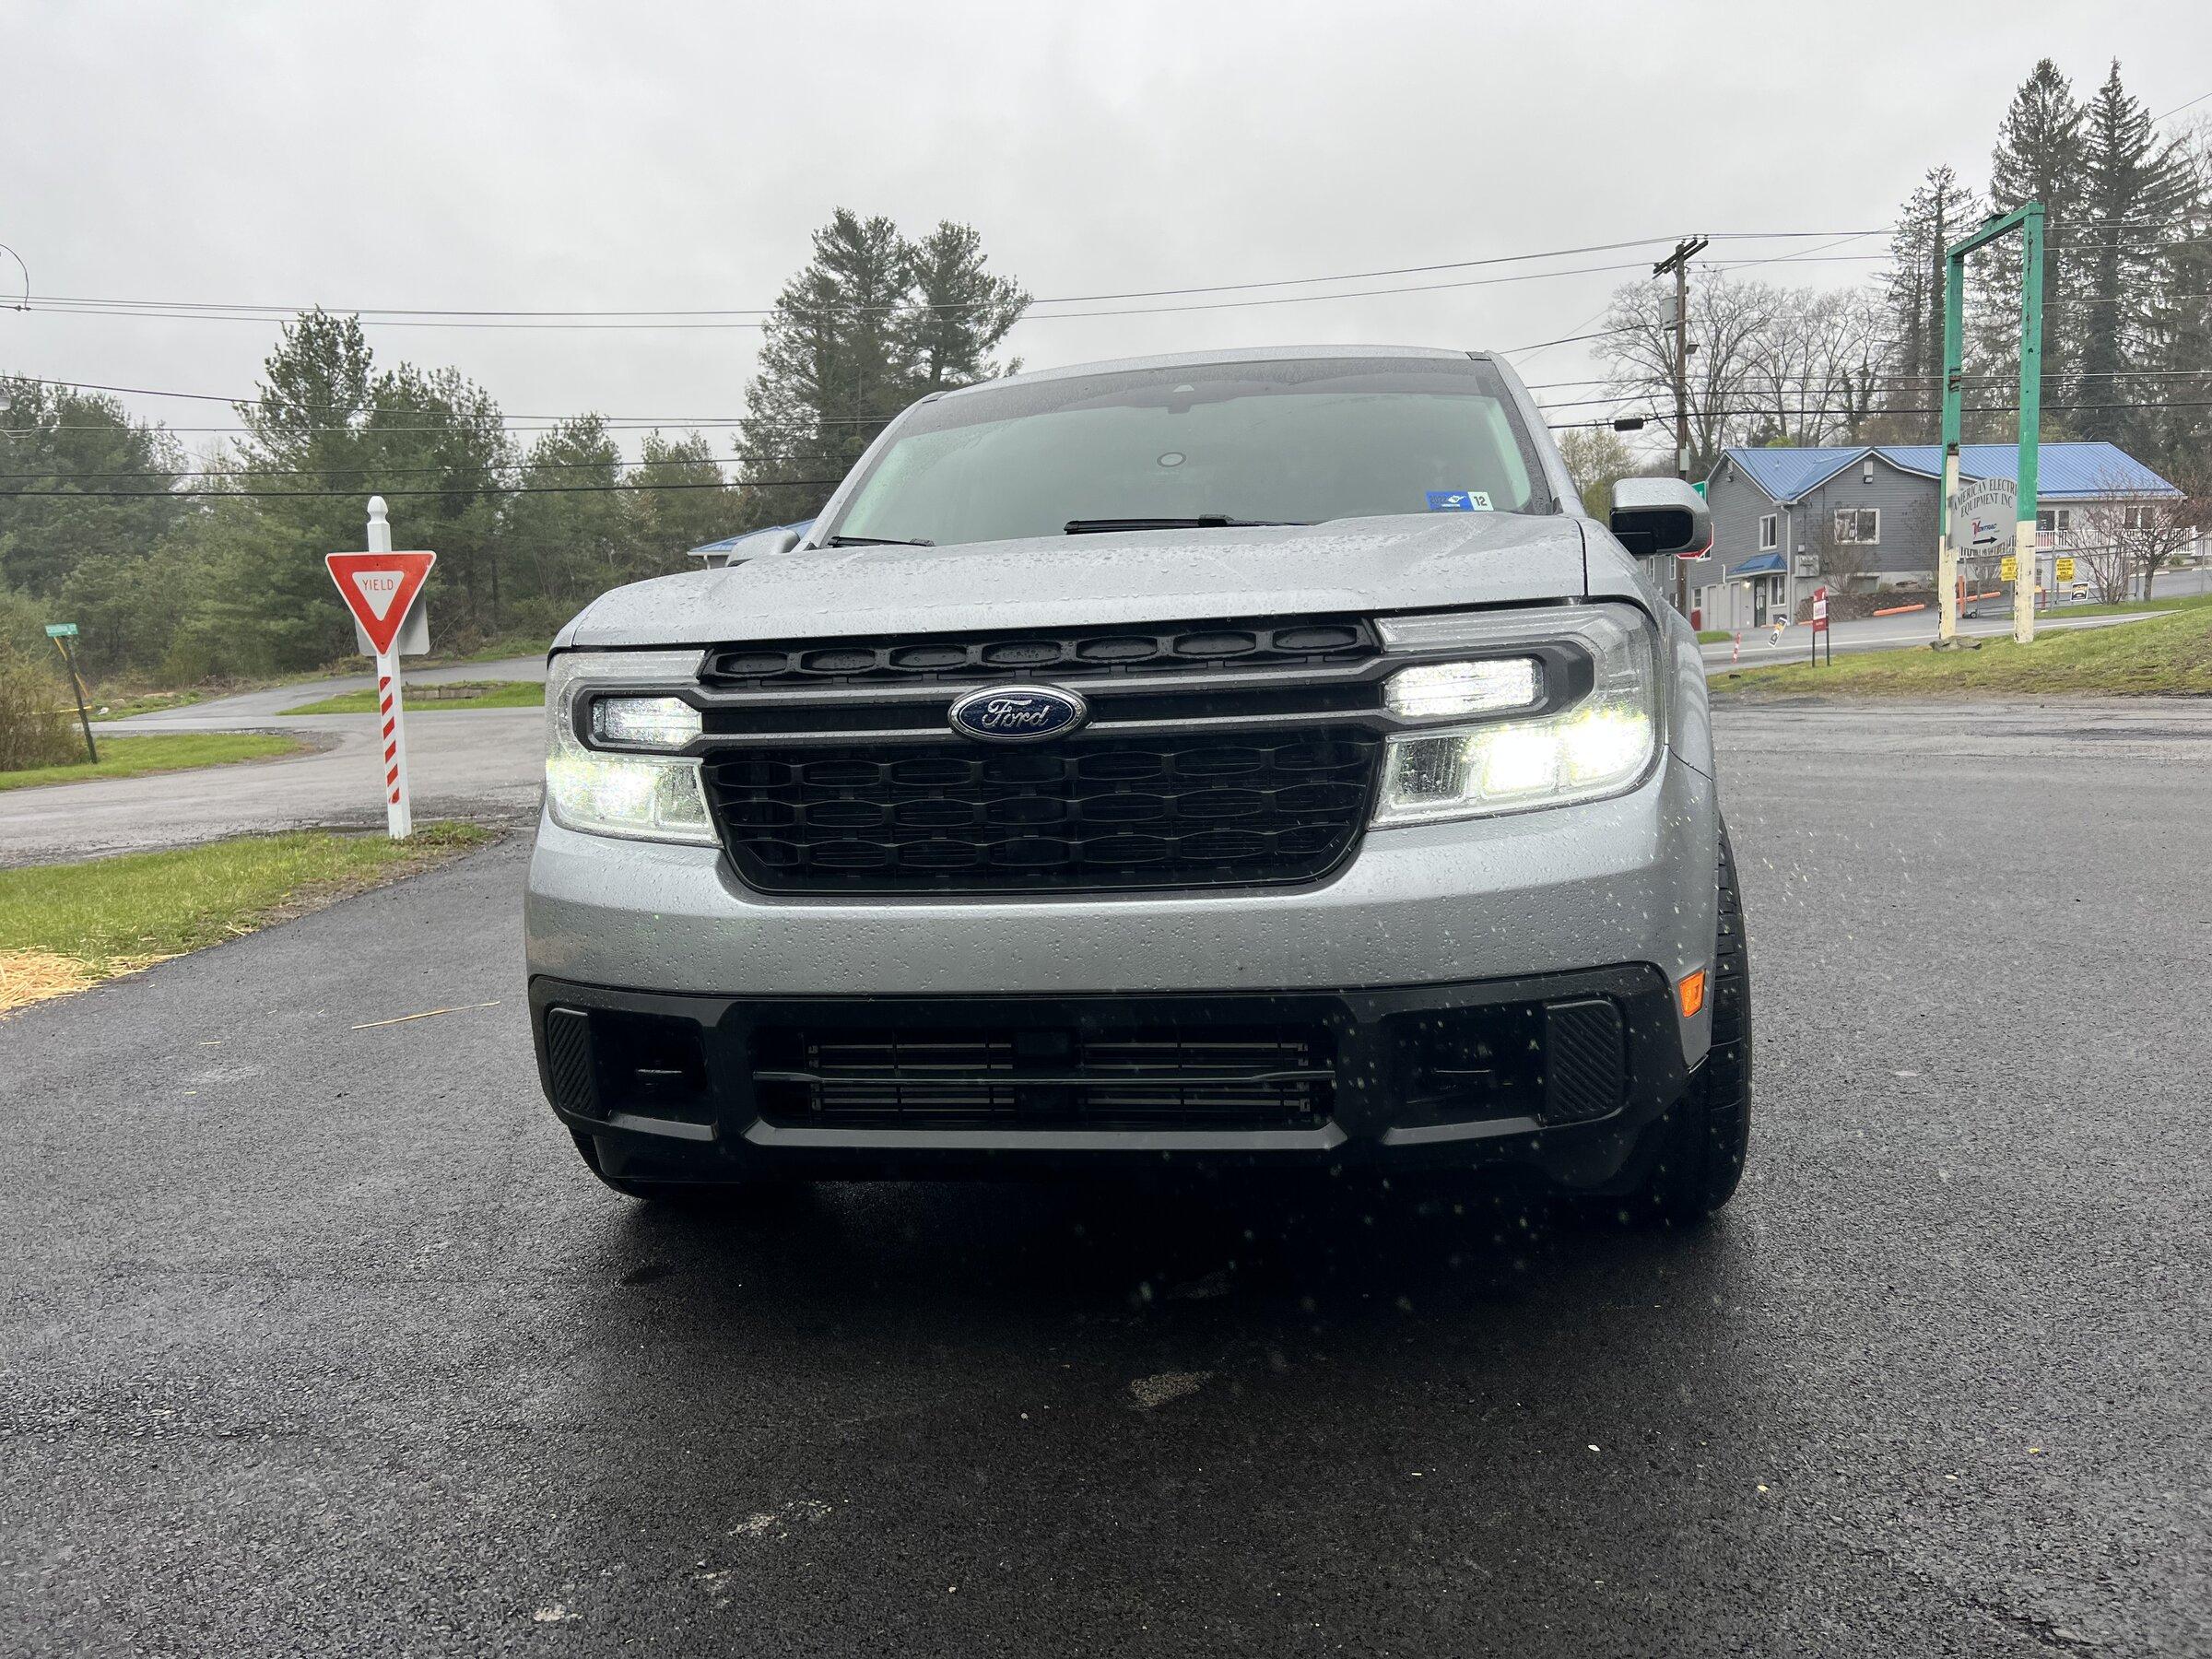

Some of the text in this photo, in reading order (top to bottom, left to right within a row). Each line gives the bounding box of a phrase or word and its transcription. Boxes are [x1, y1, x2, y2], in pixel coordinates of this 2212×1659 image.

[1474, 496, 1488, 507] 12
[1954, 478, 2018, 511] AMERICAN ELECTRI
[1960, 492, 2013, 518] EQUIPMENT INC
[362, 579, 394, 591] YIELD
[981, 698, 1051, 730] Ford
